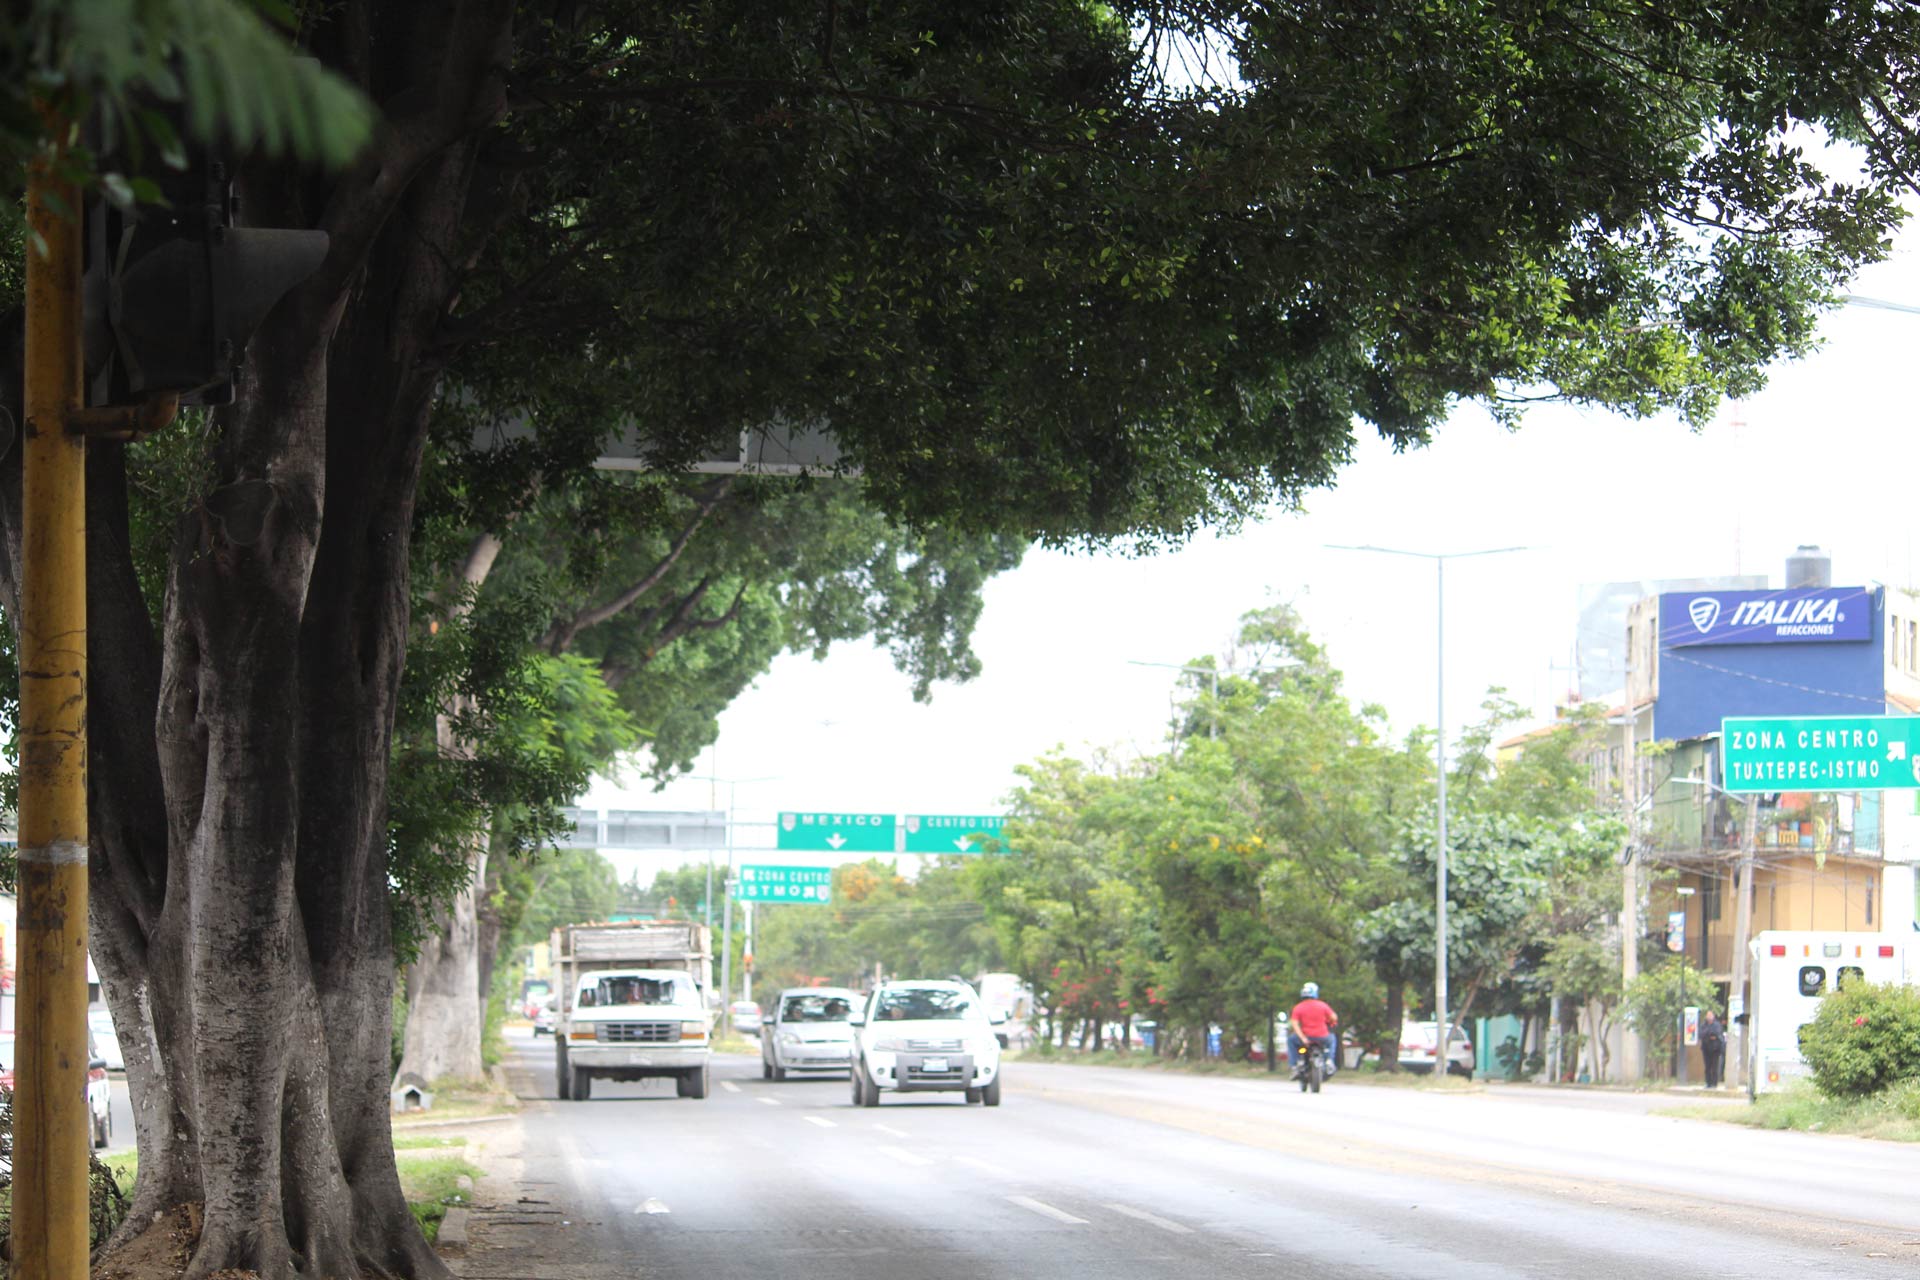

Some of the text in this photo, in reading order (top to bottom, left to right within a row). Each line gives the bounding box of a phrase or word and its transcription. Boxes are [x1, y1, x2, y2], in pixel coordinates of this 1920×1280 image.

[1730, 598, 1839, 626] ITALIKA
[1776, 624, 1834, 636] REFACCIONES
[1732, 729, 1879, 750] ZONA CENTRO
[1733, 760, 1880, 781] TUXTEPEC-ISTMO
[802, 814, 883, 827] MEXICO
[927, 816, 977, 829] CENTRO
[758, 869, 831, 884] ZONA CENTRO
